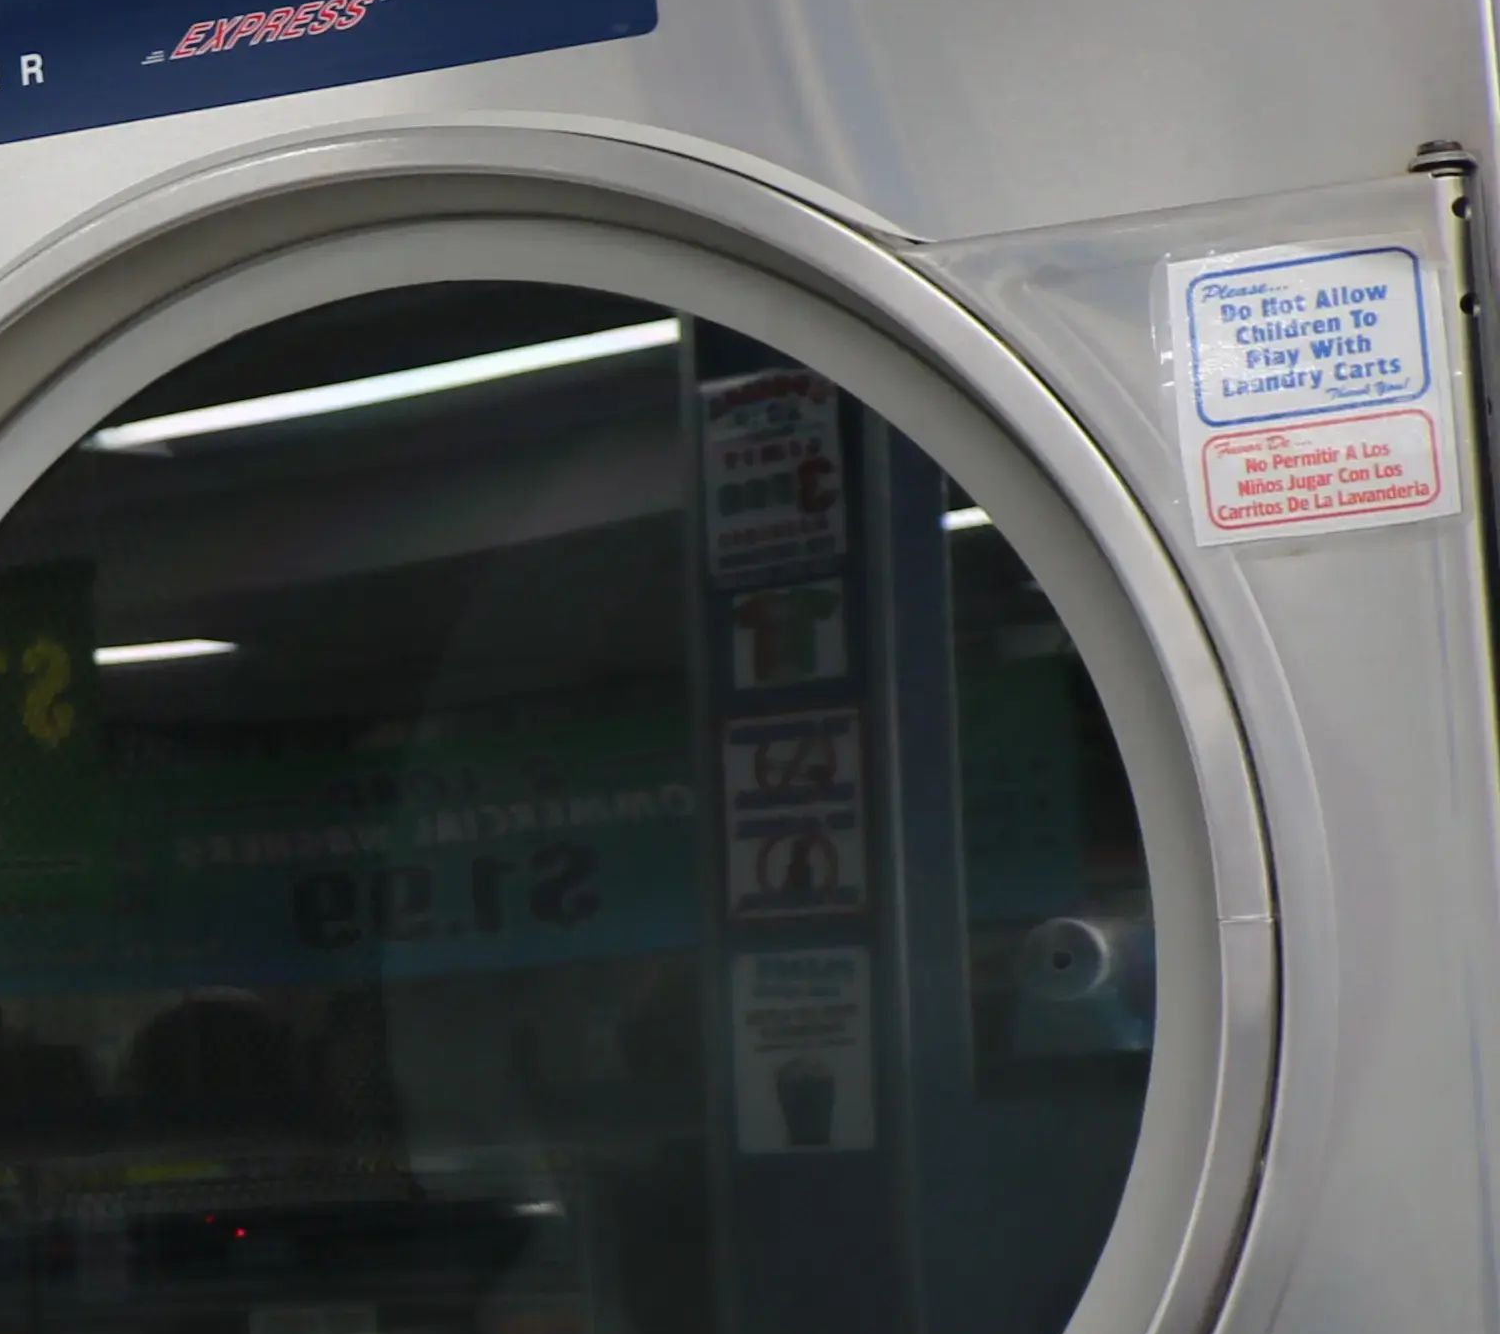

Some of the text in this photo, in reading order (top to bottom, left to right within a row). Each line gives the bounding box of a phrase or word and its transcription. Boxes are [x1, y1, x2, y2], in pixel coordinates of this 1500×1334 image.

[1220, 284, 1388, 323] Do Not Allow
[1235, 310, 1378, 347] Children To
[1246, 337, 1372, 371] Play With
[1222, 357, 1402, 399] Laundry Carts
[1245, 441, 1391, 474] No Permitir A Los
[1238, 463, 1403, 497] Niños Jugar Con Los
[1217, 499, 1284, 522] Carritos
[1287, 495, 1310, 512] De
[1314, 493, 1334, 509] La
